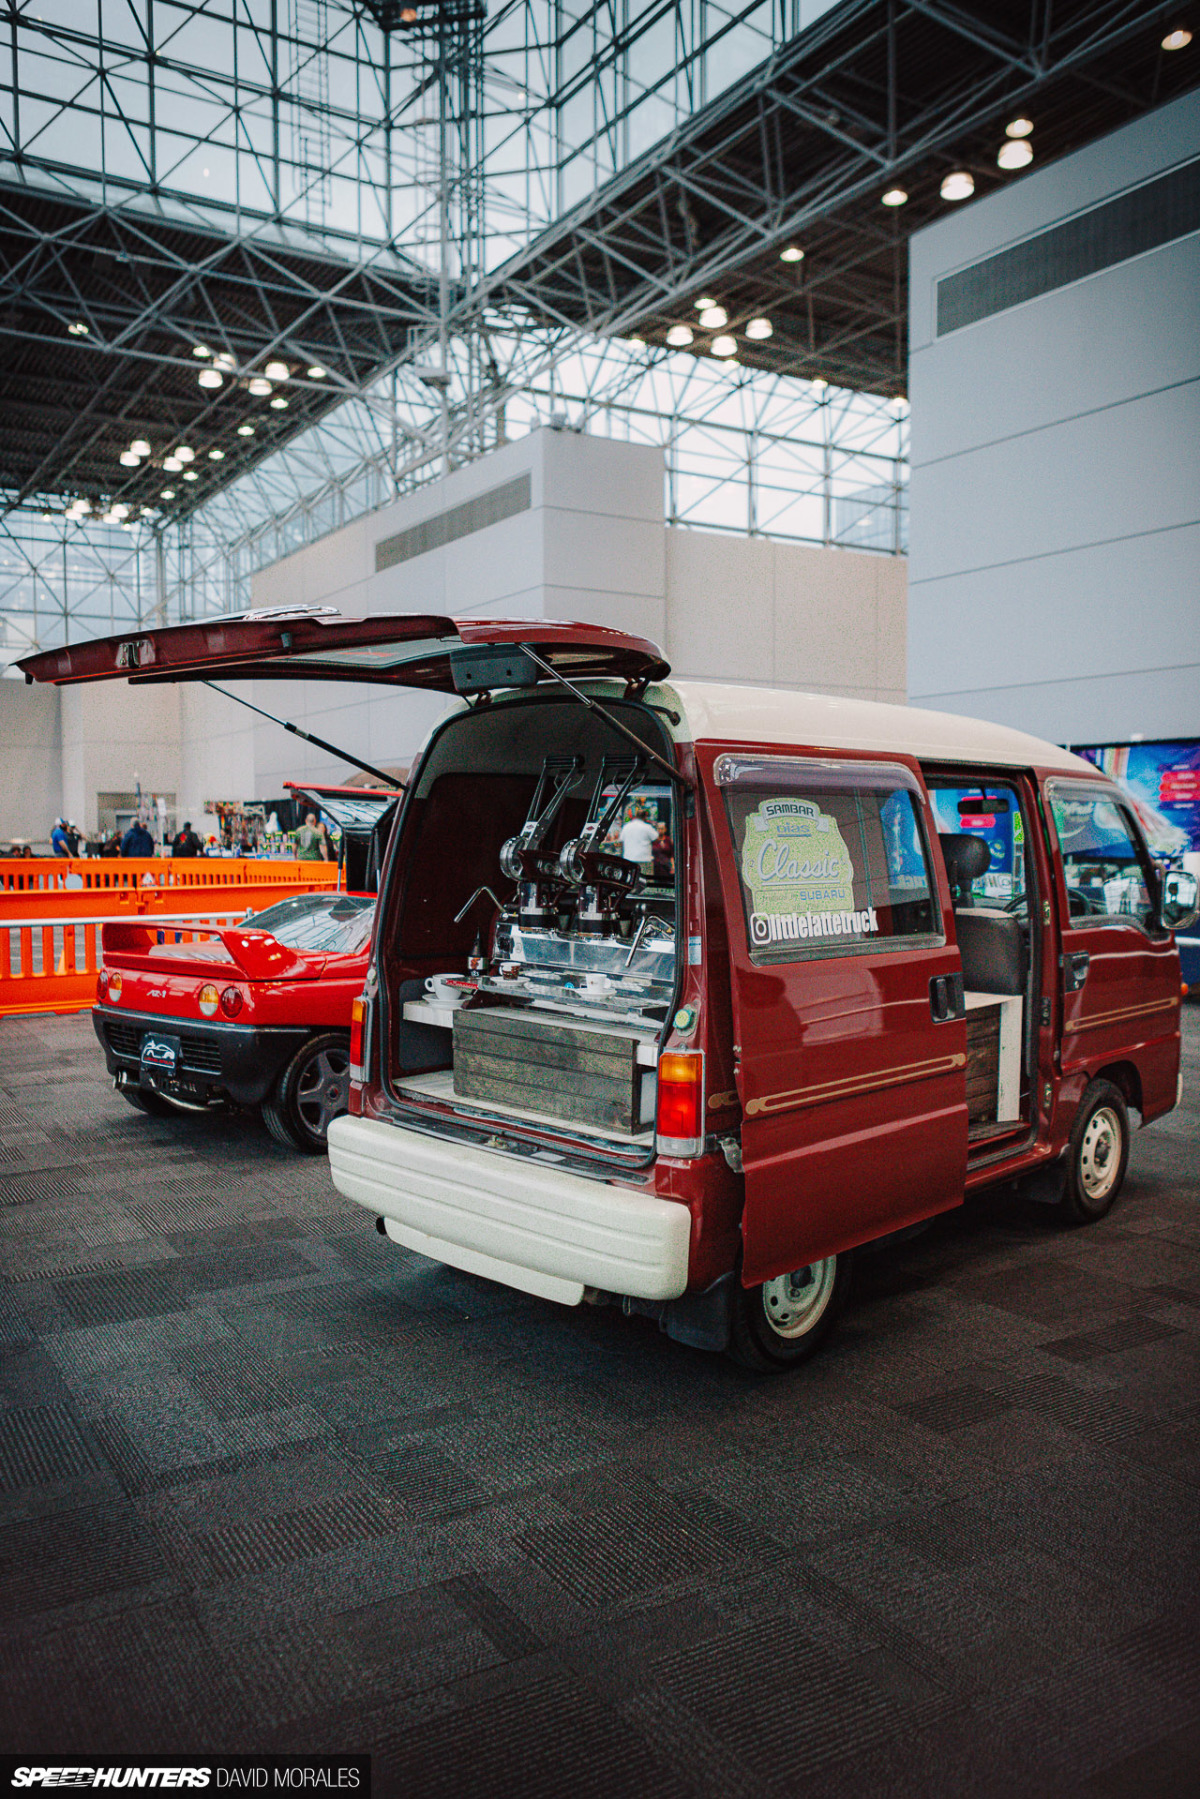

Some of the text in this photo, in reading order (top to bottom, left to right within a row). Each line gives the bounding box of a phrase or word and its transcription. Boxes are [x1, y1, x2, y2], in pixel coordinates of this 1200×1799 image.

[766, 804, 814, 817] SAMBAR
[757, 838, 839, 881] Classic
[800, 889, 845, 901] SUBARU
[770, 906, 879, 941] littlelattetruck
